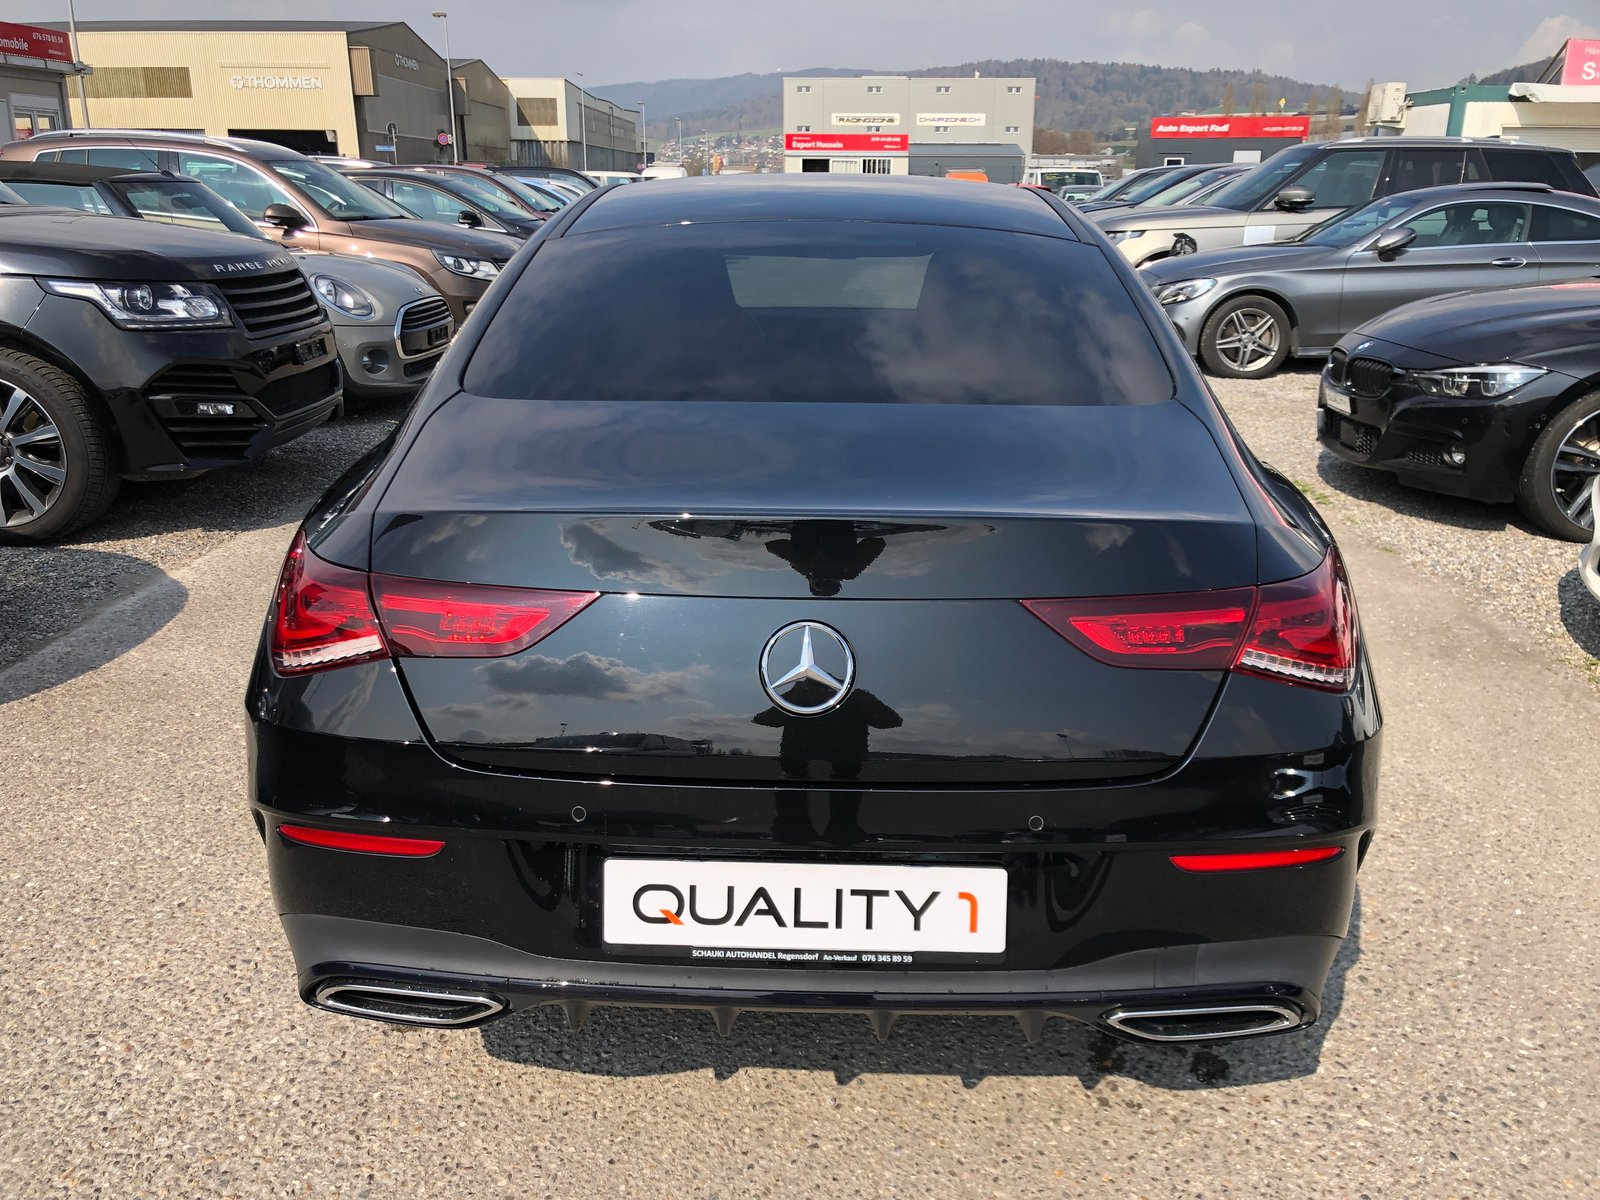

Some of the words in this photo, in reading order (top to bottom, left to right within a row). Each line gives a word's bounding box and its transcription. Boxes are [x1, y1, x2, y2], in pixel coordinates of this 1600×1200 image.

[245, 75, 323, 90] THOMMEN
[1156, 124, 1179, 132] Auto
[1179, 124, 1209, 133] Export
[1209, 123, 1230, 132] Fadi
[792, 141, 815, 150] Export
[816, 141, 844, 149] Hussein
[213, 261, 264, 273] RANGE
[632, 883, 942, 932] QUALITY
[957, 891, 979, 933] 1
[692, 949, 725, 958] SCHAUKI
[725, 950, 777, 960] AUTOHANDEL
[777, 952, 819, 961] Regensdorf
[861, 954, 877, 962] 076
[877, 954, 891, 962] 345
[892, 955, 902, 963] 89
